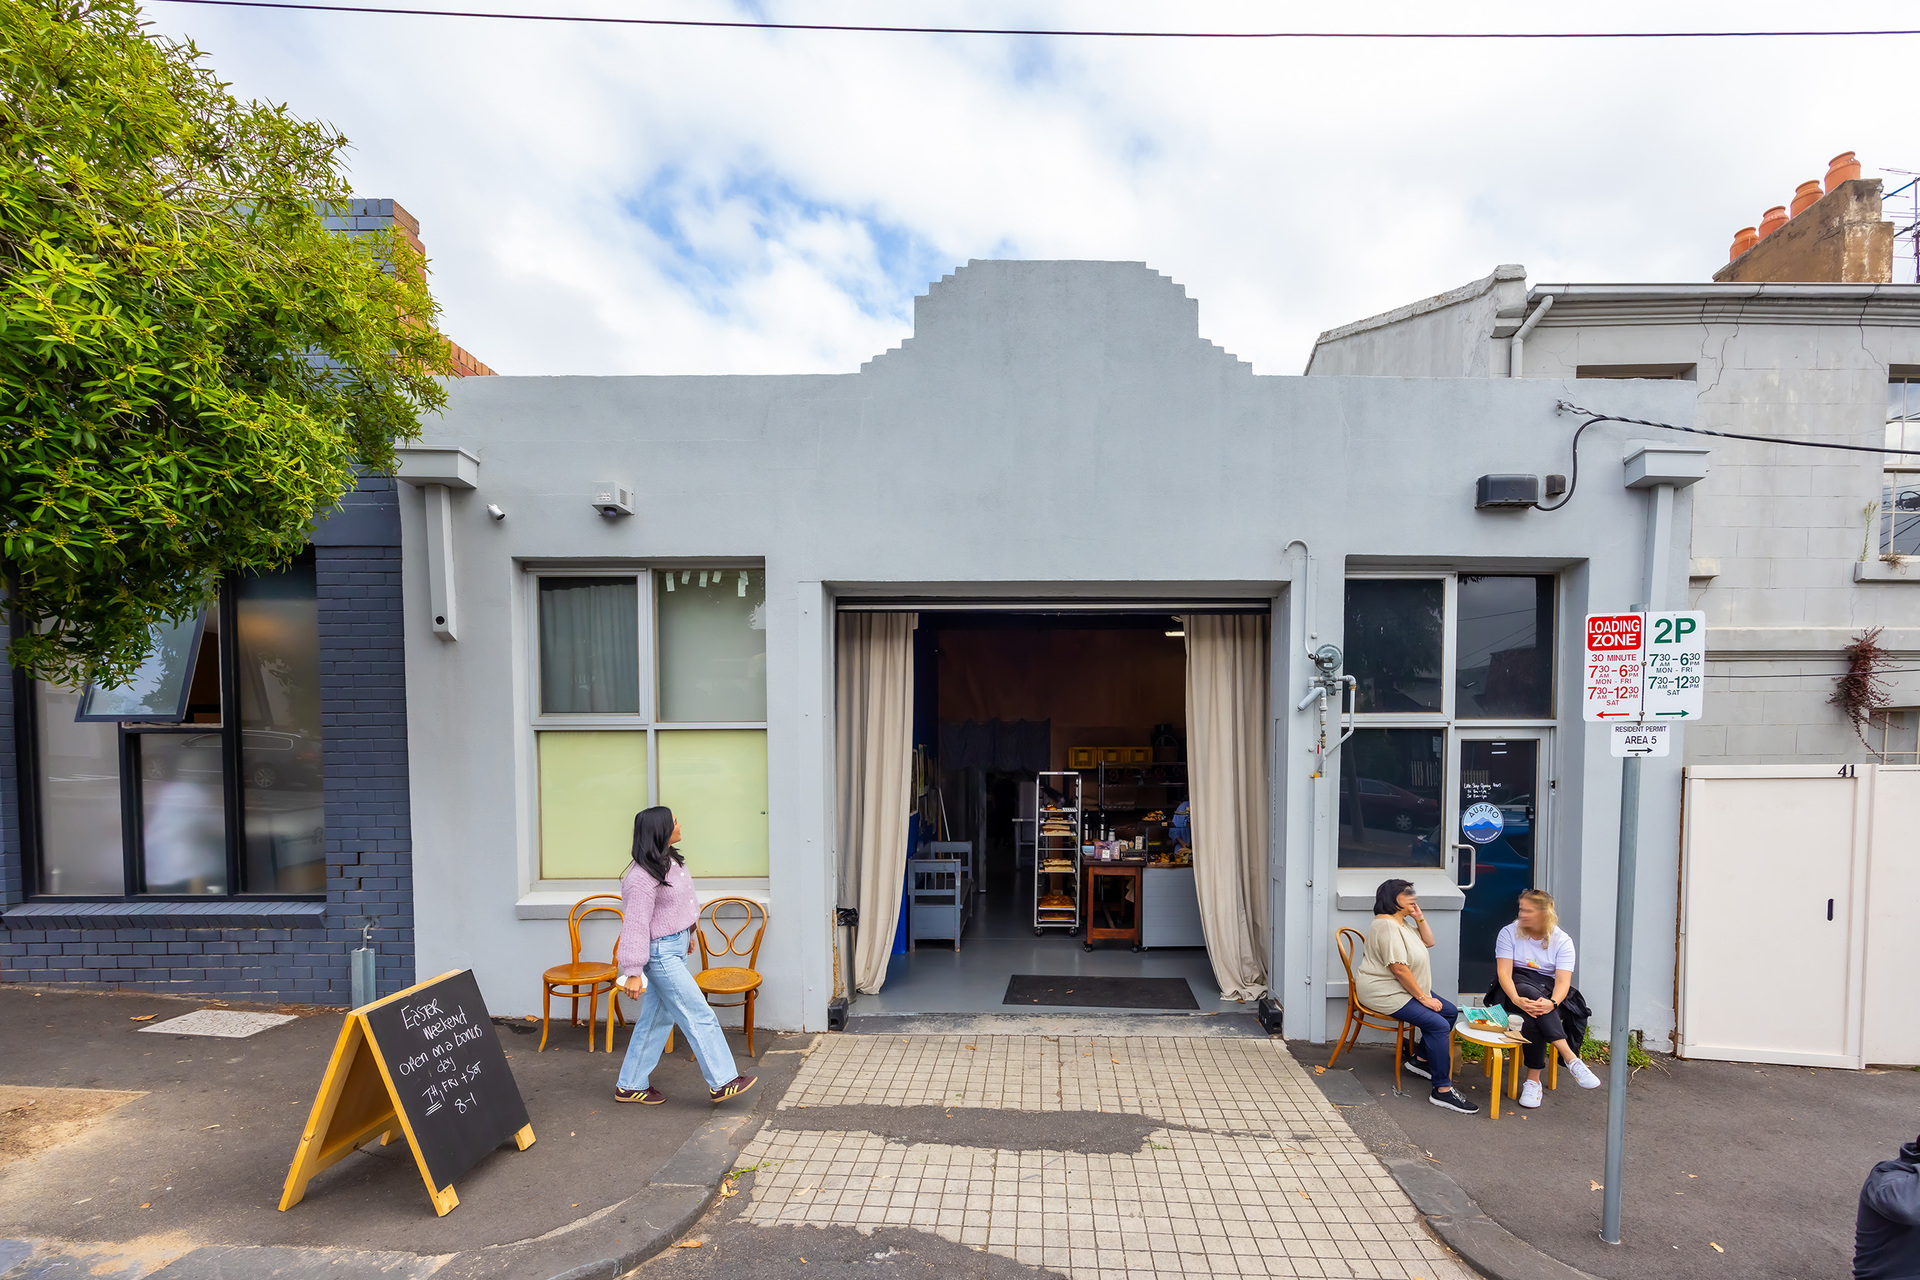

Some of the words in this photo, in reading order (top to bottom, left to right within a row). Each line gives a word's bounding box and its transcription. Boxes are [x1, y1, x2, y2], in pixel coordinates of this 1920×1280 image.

[1589, 620, 1640, 633] LOADING
[1654, 618, 1696, 643] 2P
[1592, 634, 1637, 647] ZONE
[1591, 654, 1604, 662] 30
[1615, 725, 1644, 733] RESIDENT
[1625, 735, 1648, 744] AREA
[1651, 735, 1657, 745] 5
[1837, 764, 1855, 777] 41
[1468, 804, 1500, 819] AUSTRO
[432, 1044, 445, 1058] on
[445, 1041, 454, 1051] a
[453, 1024, 483, 1047] bonus
[437, 1056, 457, 1073] day
